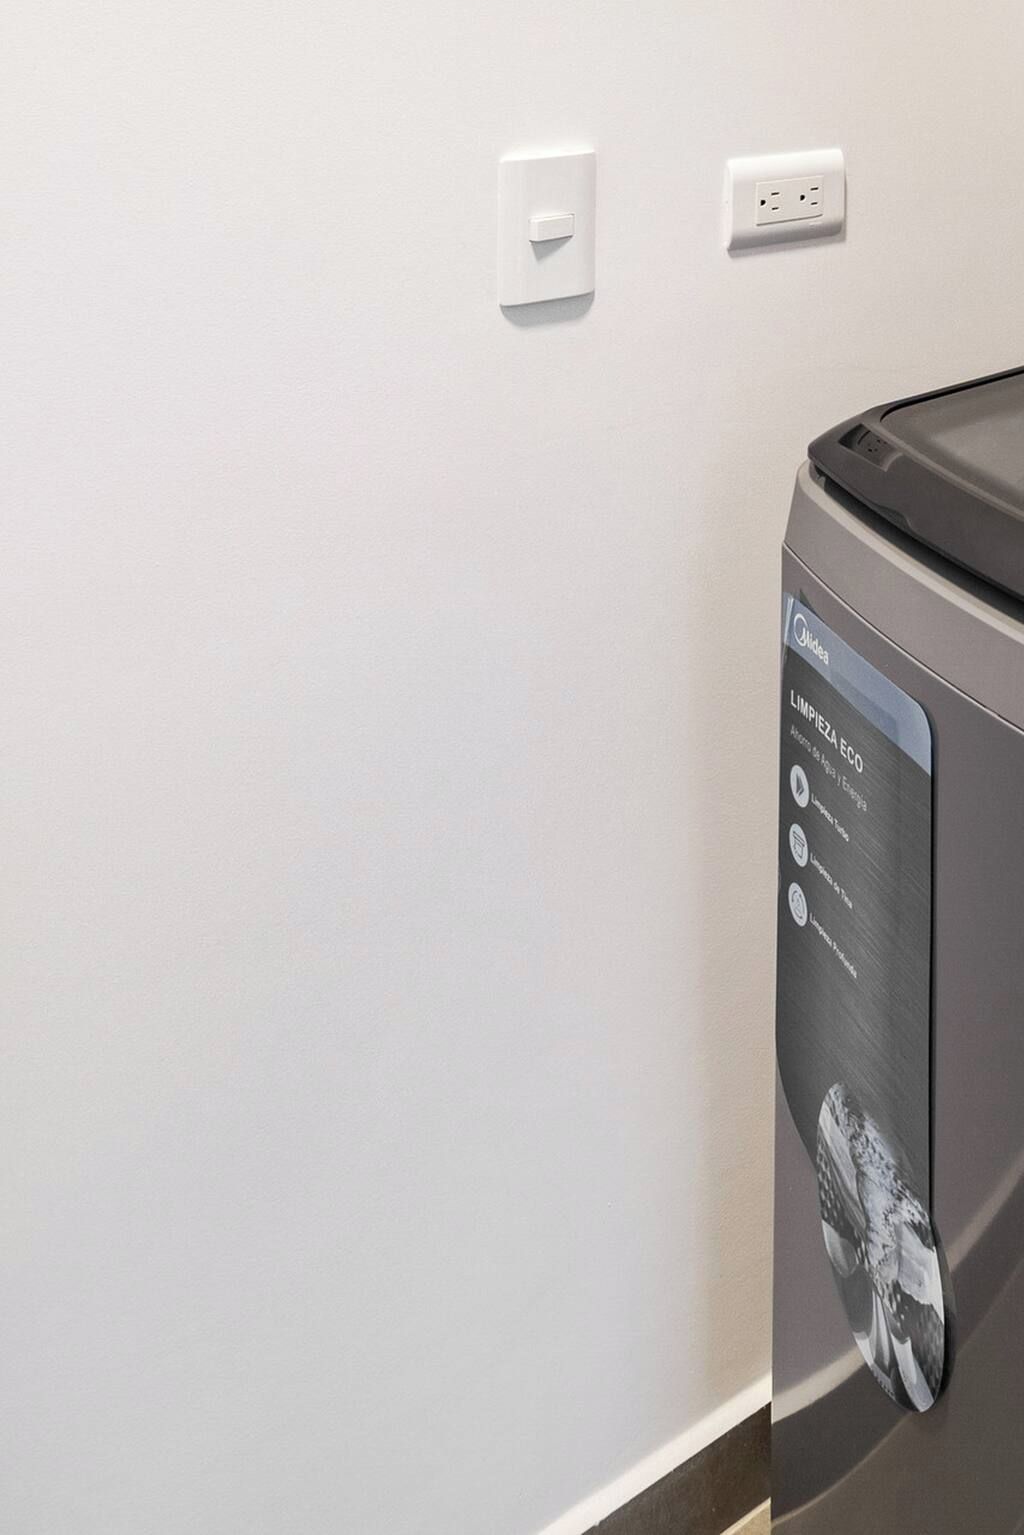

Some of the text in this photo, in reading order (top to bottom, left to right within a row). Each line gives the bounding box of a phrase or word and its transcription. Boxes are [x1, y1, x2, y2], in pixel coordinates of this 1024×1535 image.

[793, 613, 829, 665] Midea
[790, 689, 863, 773] LIMPIEZA ECO
